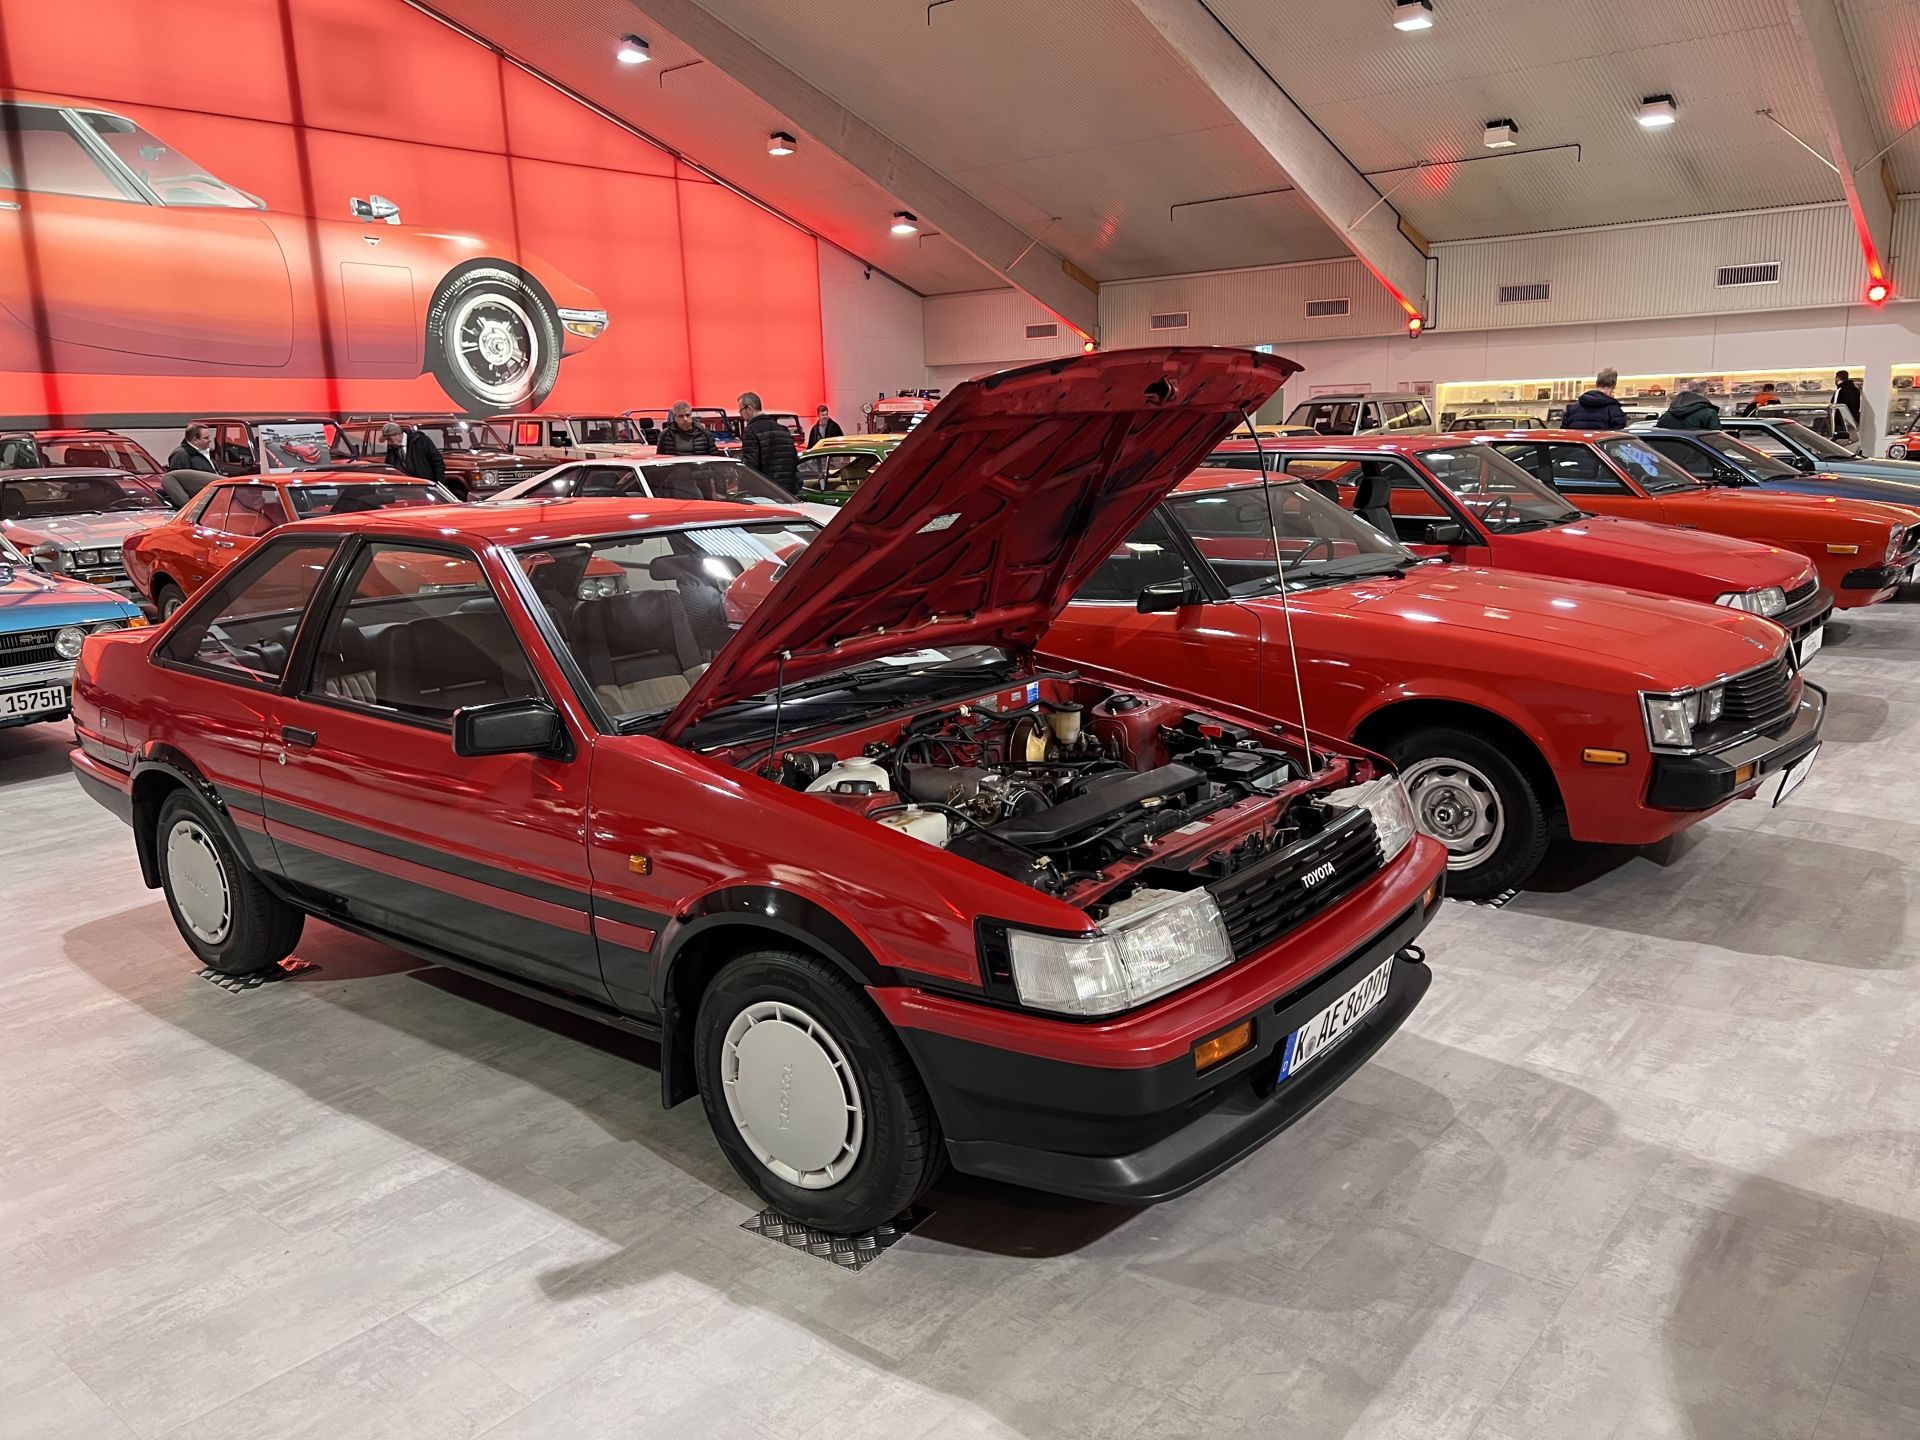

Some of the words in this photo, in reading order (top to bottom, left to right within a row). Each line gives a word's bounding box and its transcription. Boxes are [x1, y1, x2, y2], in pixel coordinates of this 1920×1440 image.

[6, 689, 62, 713] 1575H
[1302, 861, 1336, 888] TOYOTA
[1293, 1025, 1310, 1066] K
[1317, 1000, 1343, 1048] AE
[1343, 958, 1392, 1026] 8699H
[779, 1063, 793, 1131] TOYOTA
